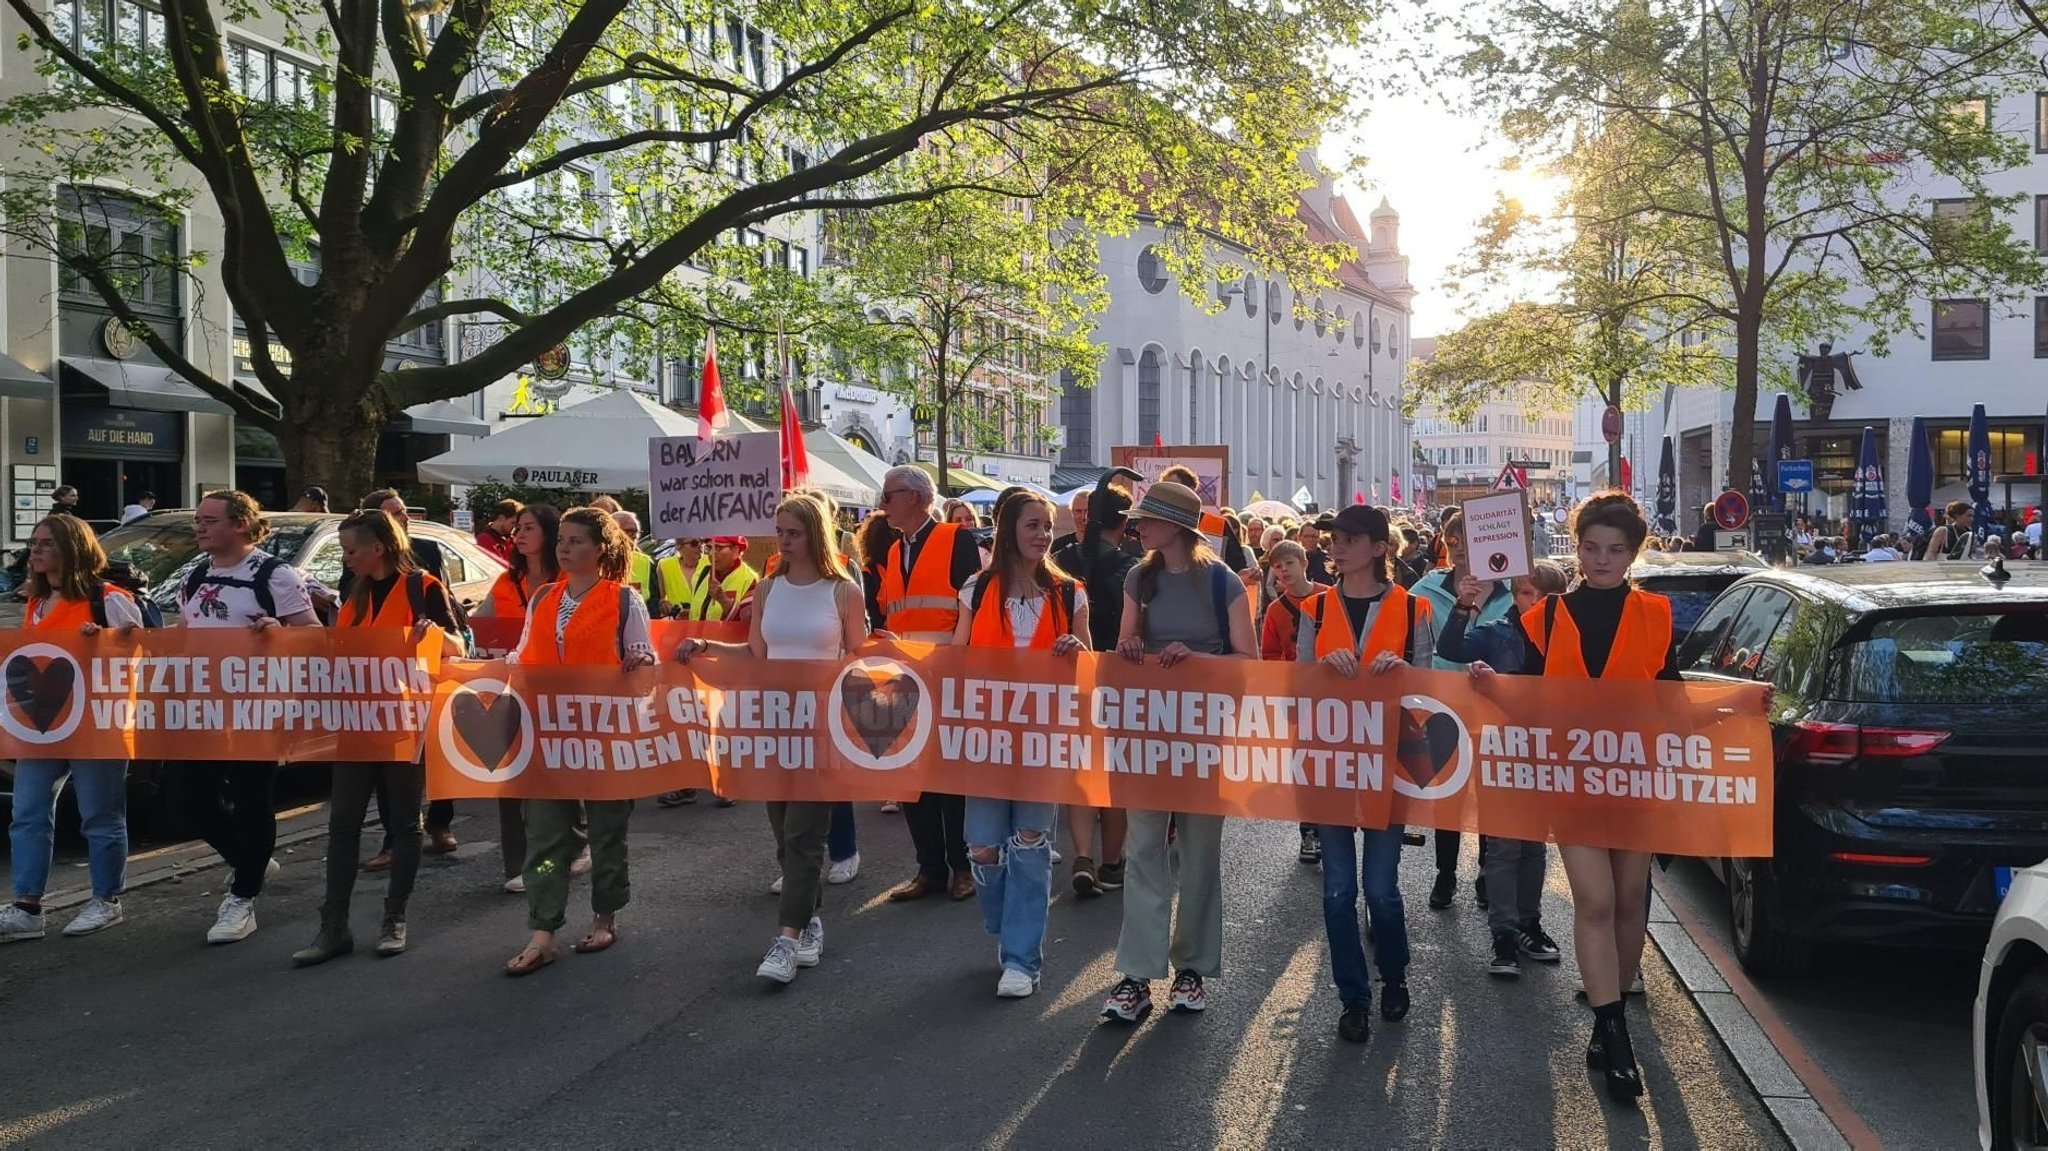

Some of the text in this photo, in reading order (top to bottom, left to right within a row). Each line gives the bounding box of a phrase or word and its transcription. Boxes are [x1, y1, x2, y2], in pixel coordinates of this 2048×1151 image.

[87, 428, 154, 445] AUF DIE HAND
[660, 439, 742, 467] BAYRN
[530, 469, 599, 485] PAULANER
[659, 467, 769, 492] war schon mal
[659, 490, 777, 524] der ANFANG
[1473, 531, 1519, 544] REPRESSION
[91, 655, 432, 694] LETZTE GENERATION
[90, 699, 431, 732] VOR DEN KIPPPUNKTEN
[536, 692, 660, 734] LETZTE
[939, 677, 1385, 746] LETZTE GENERATION
[539, 737, 606, 771] VOR
[611, 731, 682, 771] DEN
[938, 724, 1384, 791] VOR DEN KIPPPUNKTEN
[1478, 724, 1558, 760] ART.
[1567, 729, 1646, 765] 20A
[1656, 733, 1713, 770] GG
[1480, 760, 1757, 805] LEBEN SCHÜTZEN
